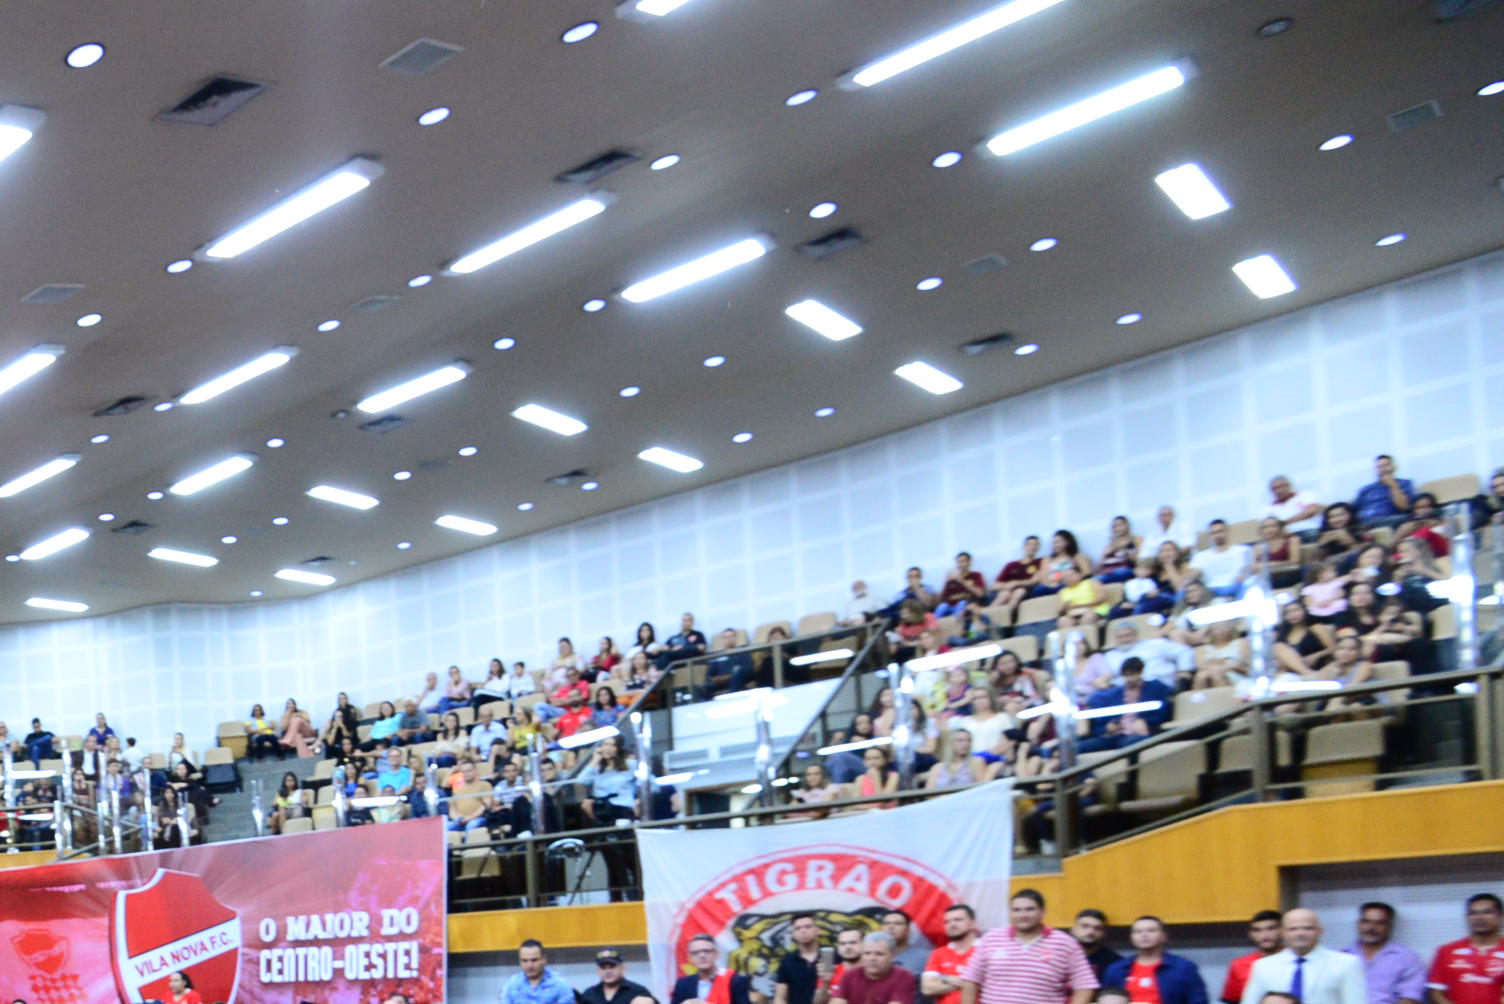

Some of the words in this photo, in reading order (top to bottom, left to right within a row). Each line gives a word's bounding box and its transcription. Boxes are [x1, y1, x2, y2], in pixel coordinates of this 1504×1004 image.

[714, 856, 914, 913] TIGRÃO
[259, 917, 277, 942] O
[286, 911, 370, 941] MAIOR
[381, 907, 420, 936] DO
[135, 955, 170, 977] VILA
[170, 939, 209, 965] NOVA
[259, 941, 420, 983] CENTRO-OESTE!
